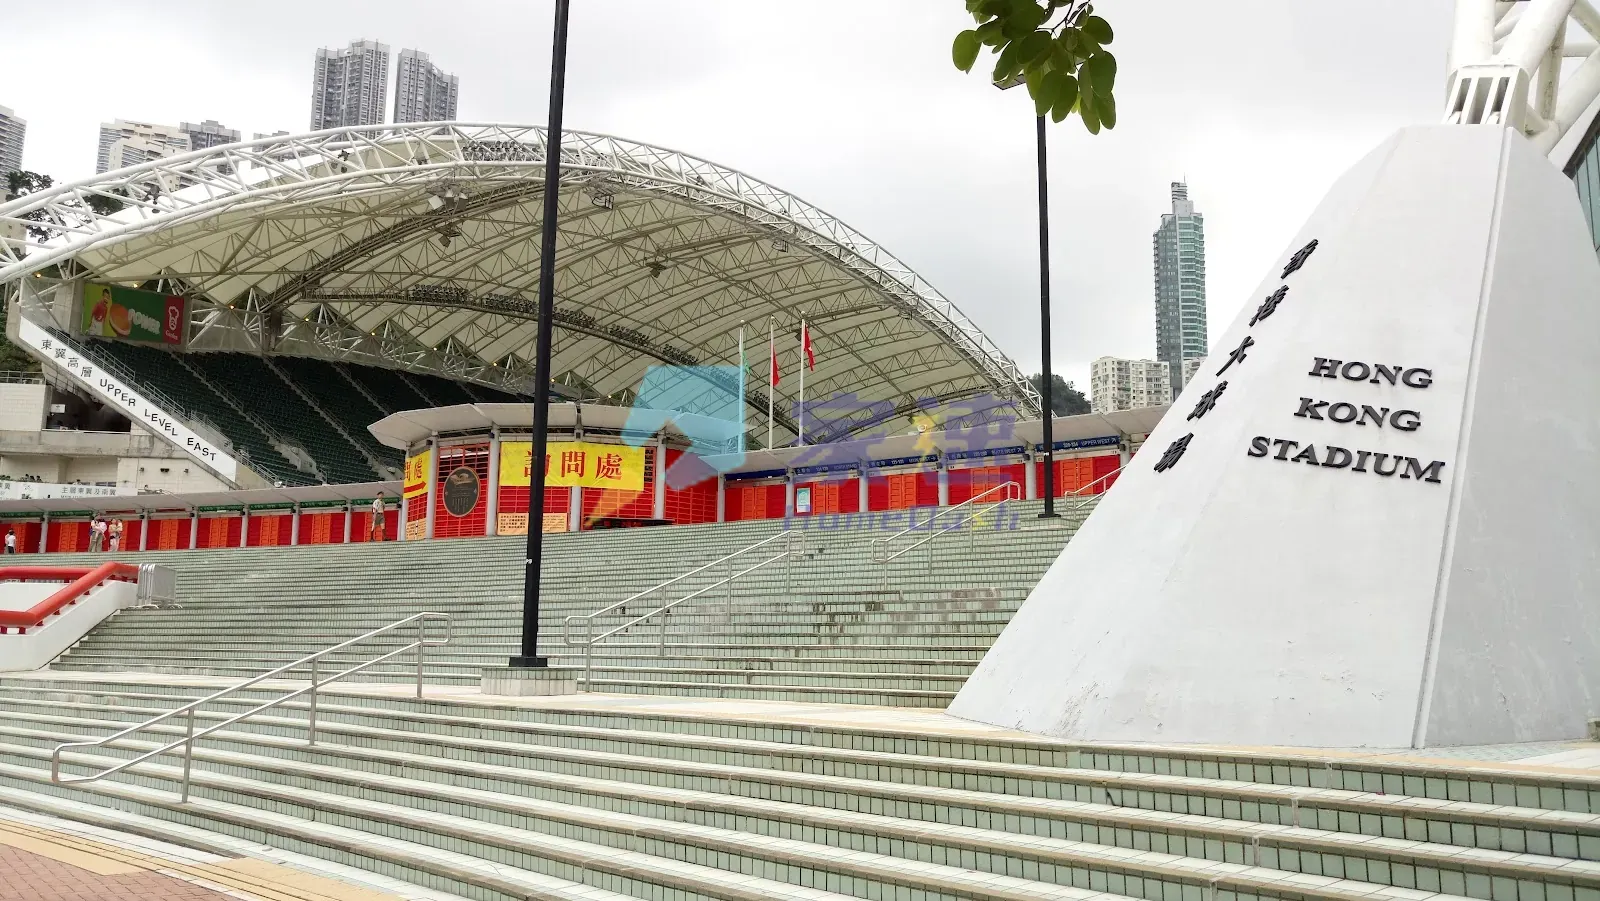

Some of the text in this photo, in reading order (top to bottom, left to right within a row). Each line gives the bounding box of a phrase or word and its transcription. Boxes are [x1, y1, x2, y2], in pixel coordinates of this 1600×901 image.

[1308, 356, 1433, 389] HONG
[41, 338, 217, 461] 東翼高層 UPPER LEVEL EAST
[1294, 397, 1422, 432] KONG
[1247, 435, 1446, 484] STADIUM
